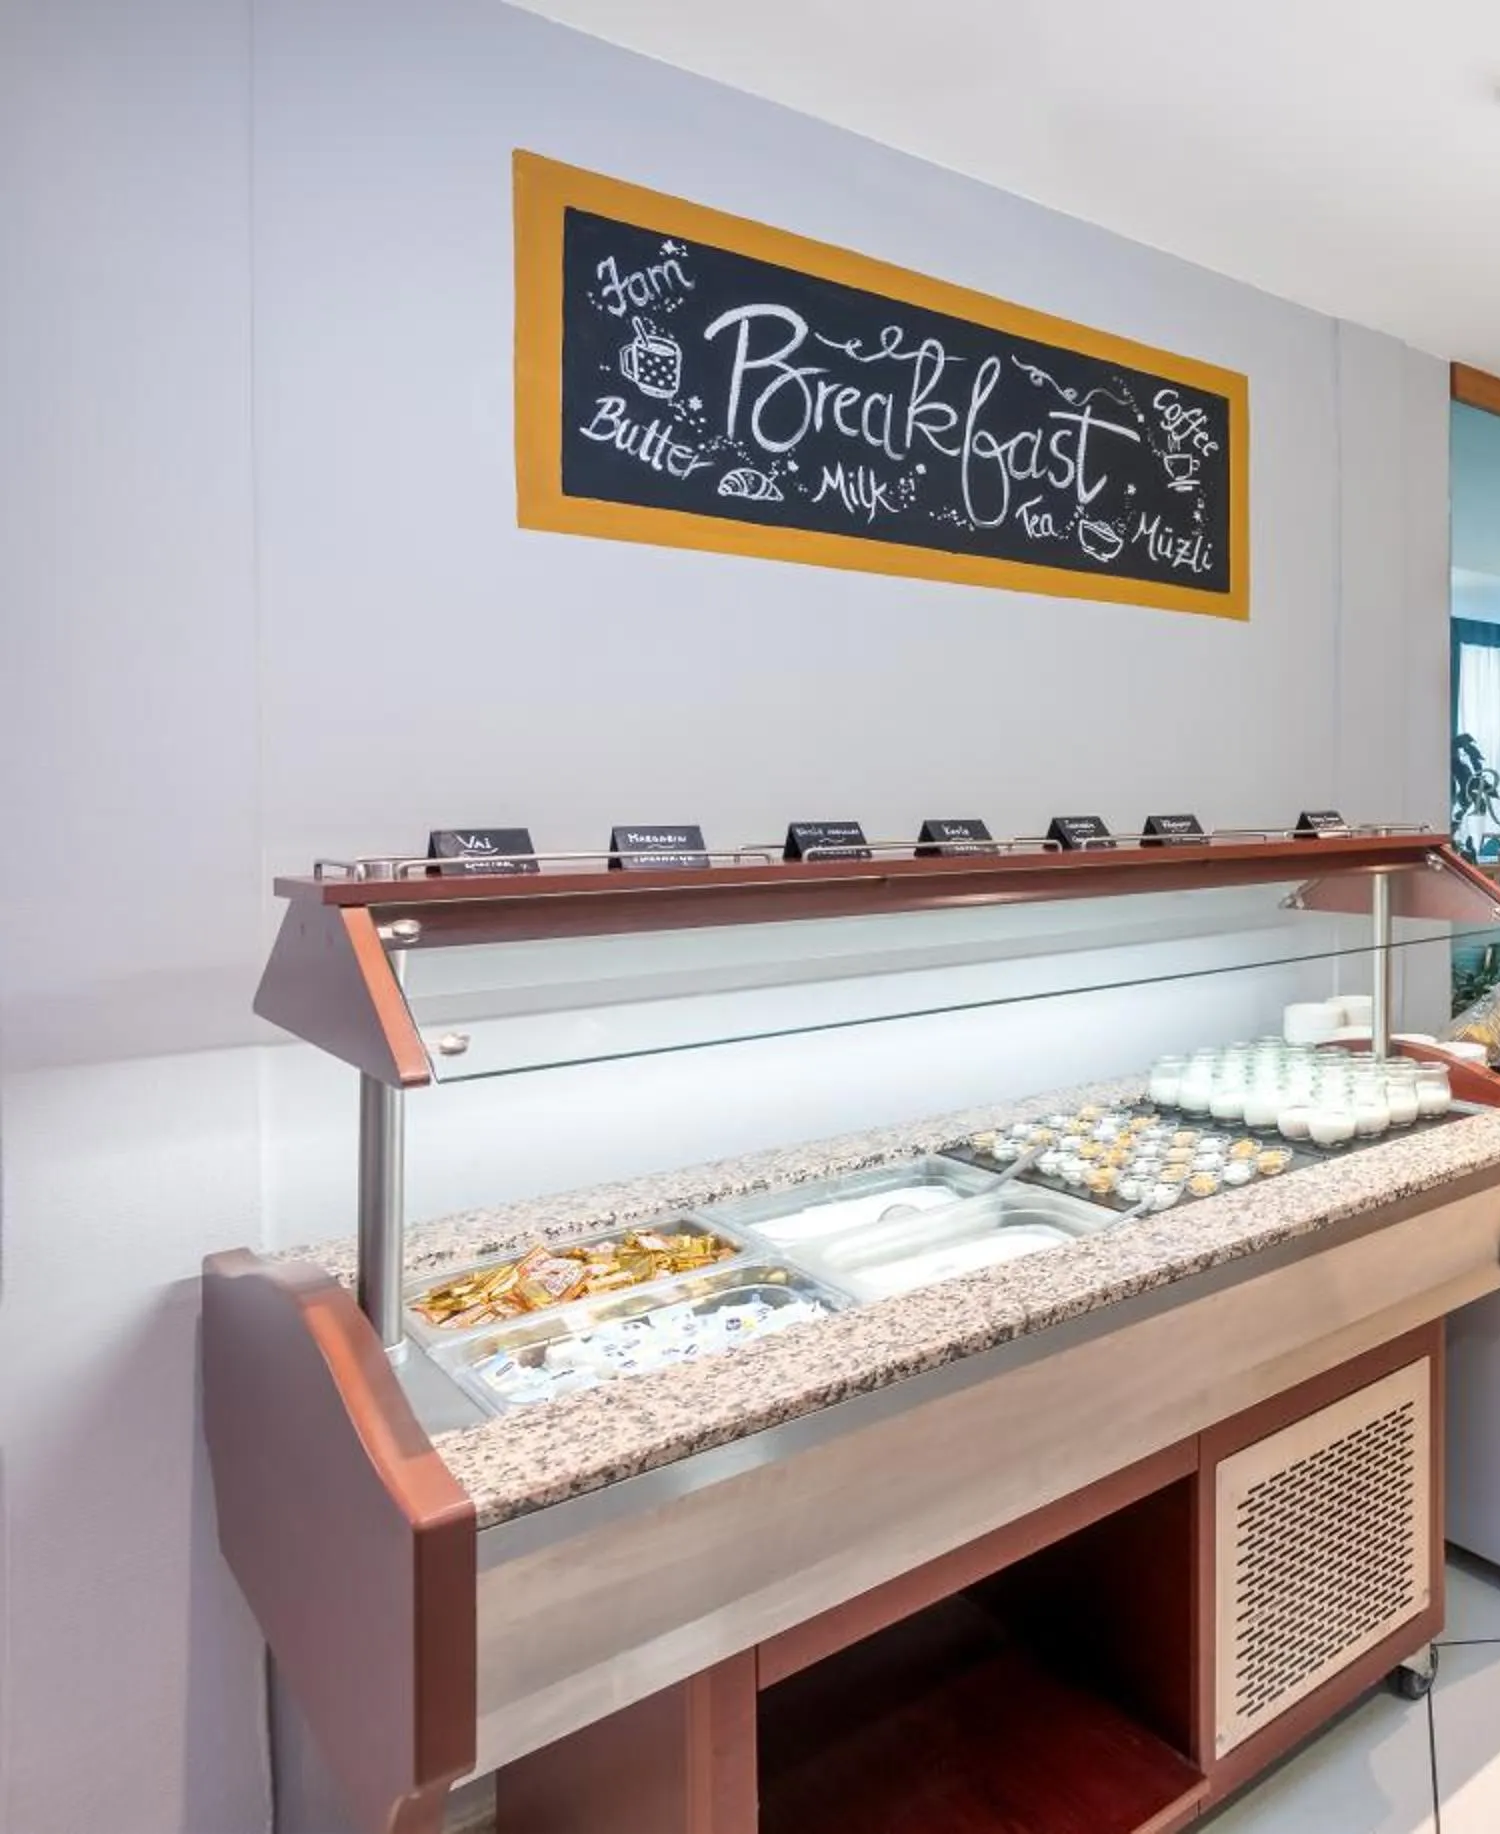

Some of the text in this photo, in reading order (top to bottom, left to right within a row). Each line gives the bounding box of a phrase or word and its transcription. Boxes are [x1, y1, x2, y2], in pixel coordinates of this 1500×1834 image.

[597, 256, 695, 317] Jam
[579, 396, 715, 480] Butter
[703, 303, 1141, 529] Breakfast
[1153, 389, 1219, 457] Coffee
[811, 461, 900, 524] Milk
[1015, 494, 1058, 539] Tea
[1132, 512, 1213, 573] Müzli
